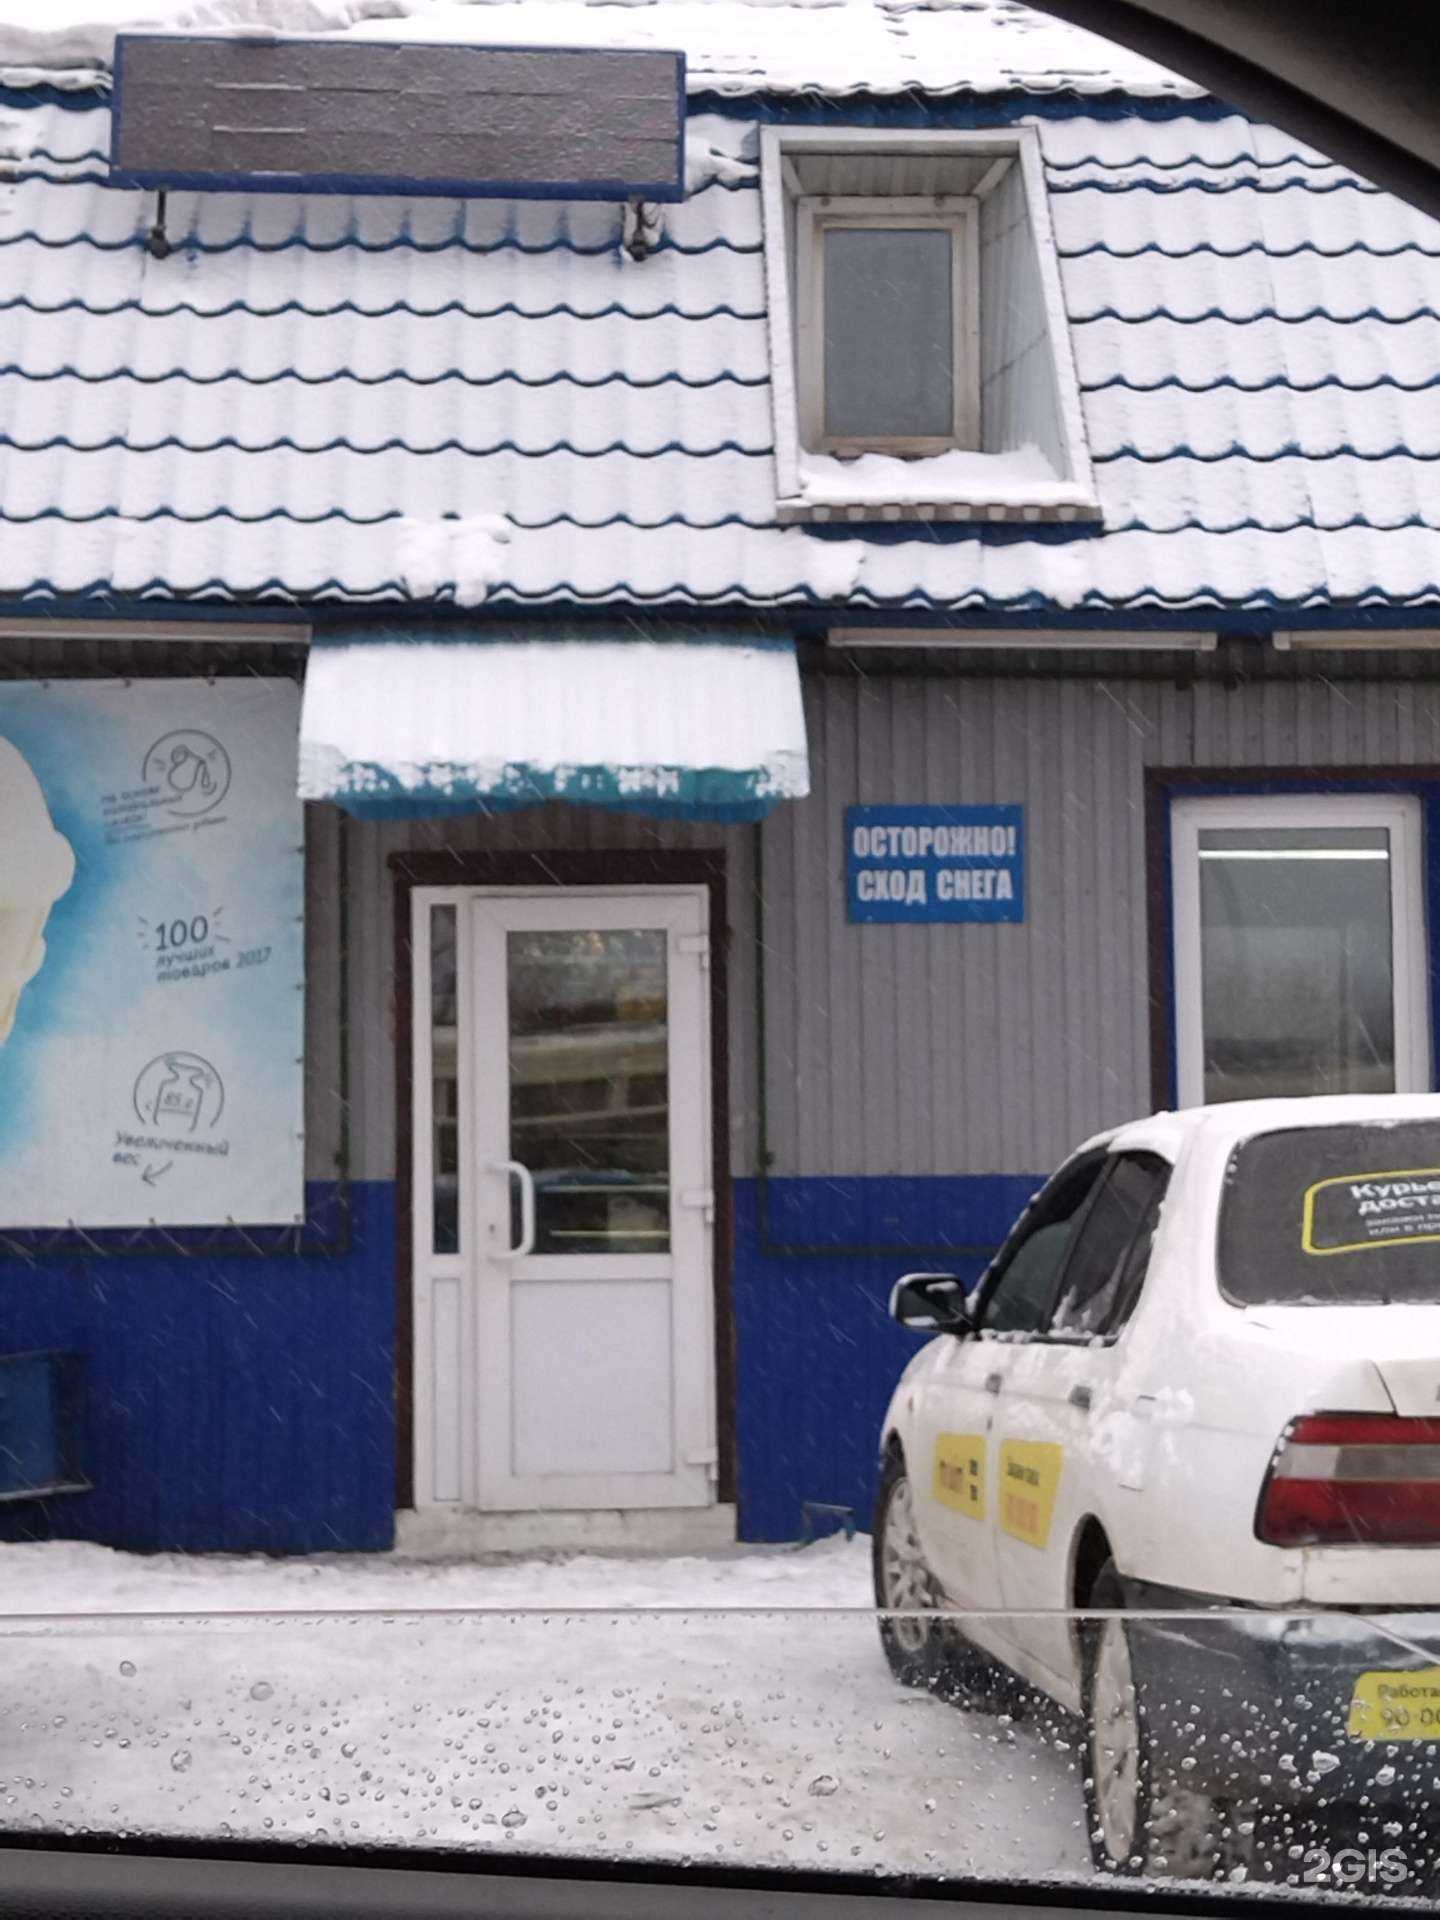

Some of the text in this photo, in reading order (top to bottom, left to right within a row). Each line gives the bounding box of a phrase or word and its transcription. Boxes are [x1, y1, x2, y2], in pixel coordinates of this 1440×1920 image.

[854, 826, 1016, 858] ОСТОРОЖНО!
[857, 869, 1013, 905] СХОД СНЕГА
[155, 915, 208, 951] 100
[157, 946, 272, 982] товаров 2017
